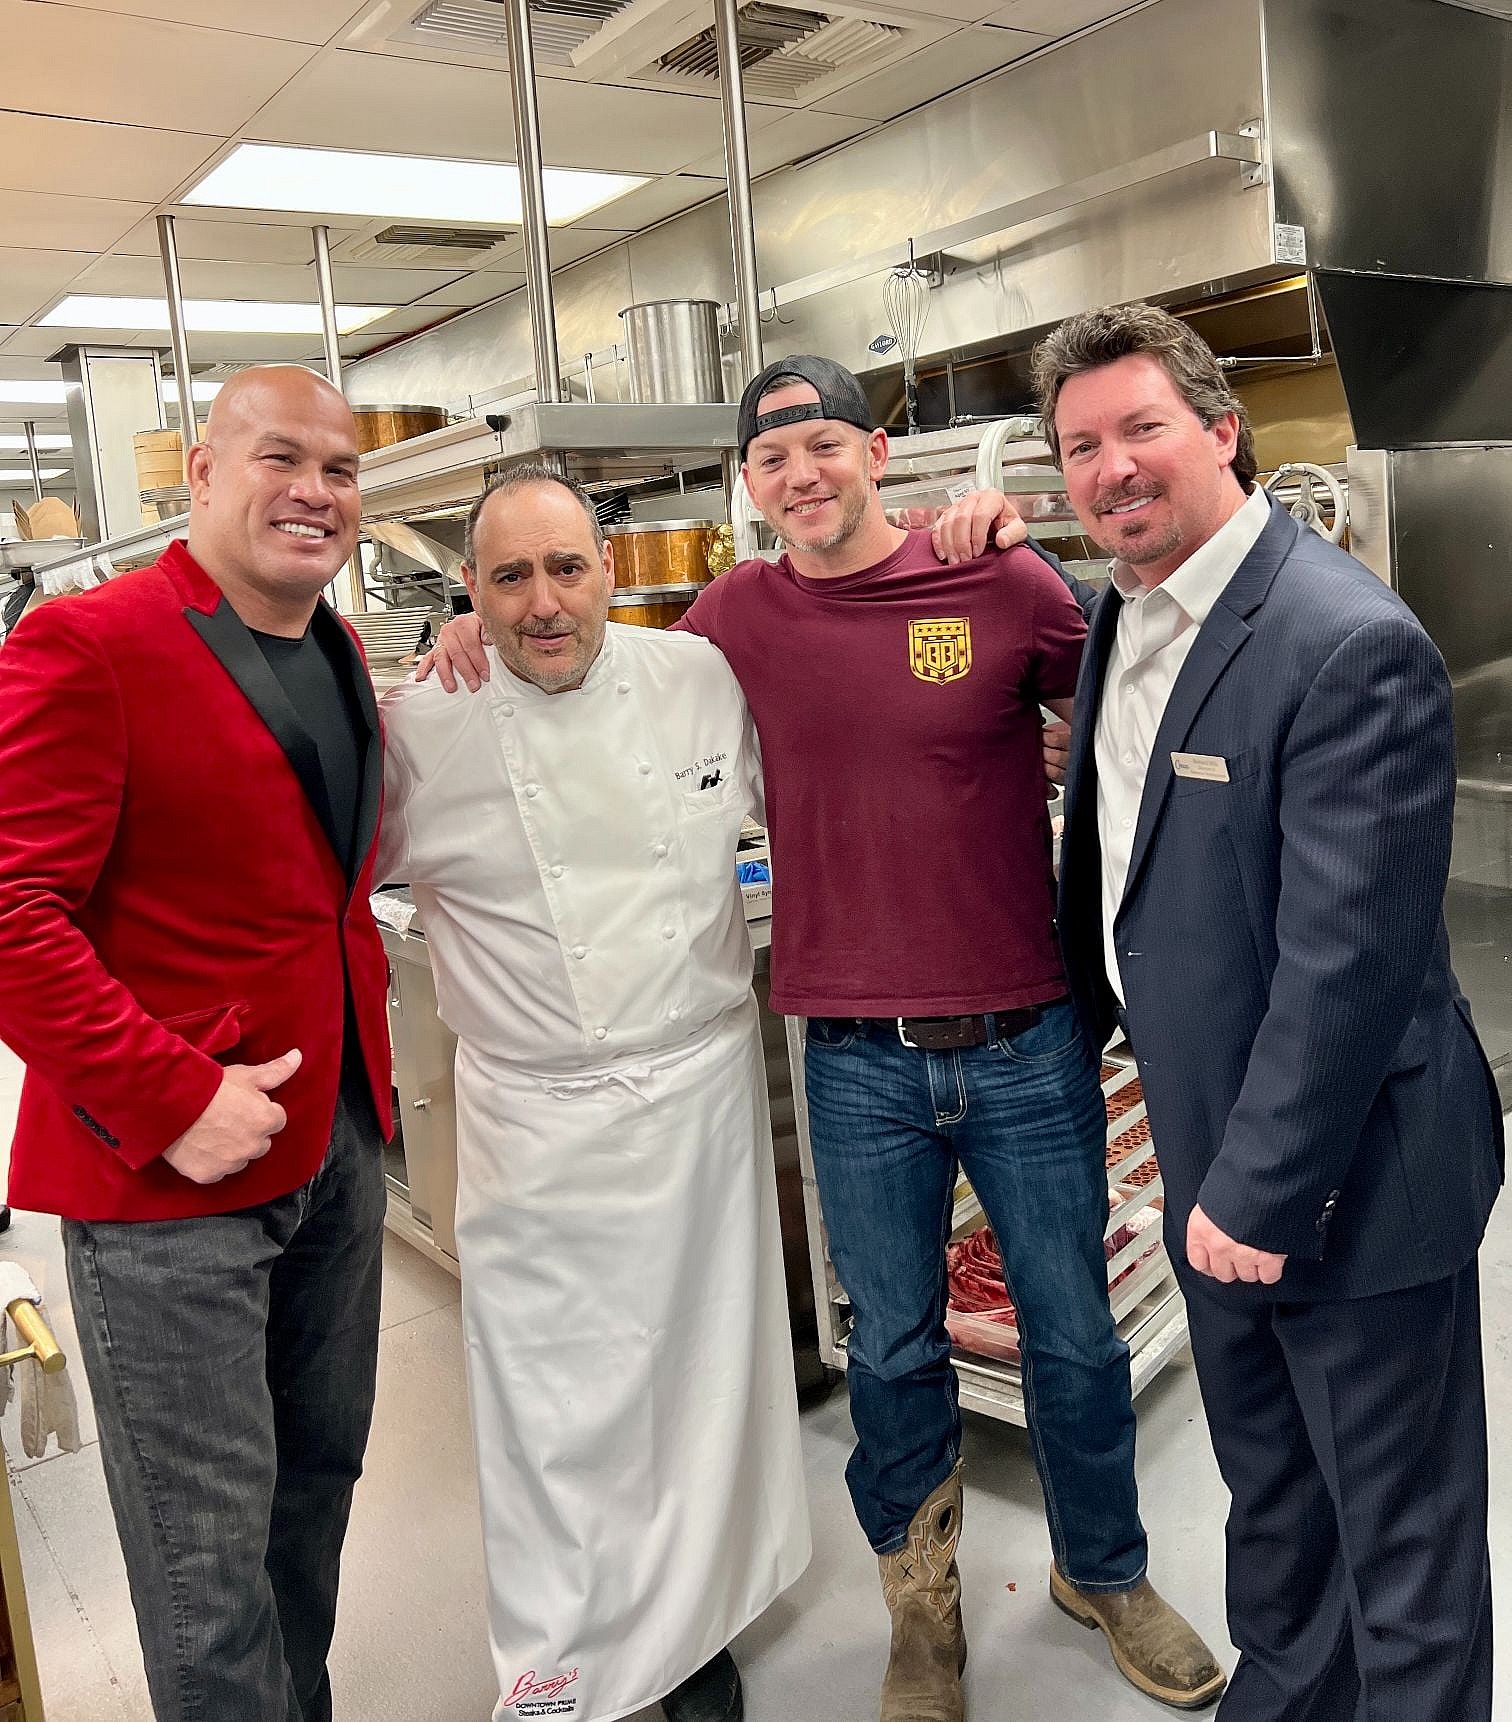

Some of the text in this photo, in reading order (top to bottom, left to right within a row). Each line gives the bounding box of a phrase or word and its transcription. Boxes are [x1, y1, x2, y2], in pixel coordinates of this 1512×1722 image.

[674, 766, 694, 780] Barry
[703, 752, 728, 767] Dakake
[503, 1667, 579, 1707] Barry's
[546, 1705, 575, 1715] Cocktails
[557, 1698, 577, 1706] PRIME
